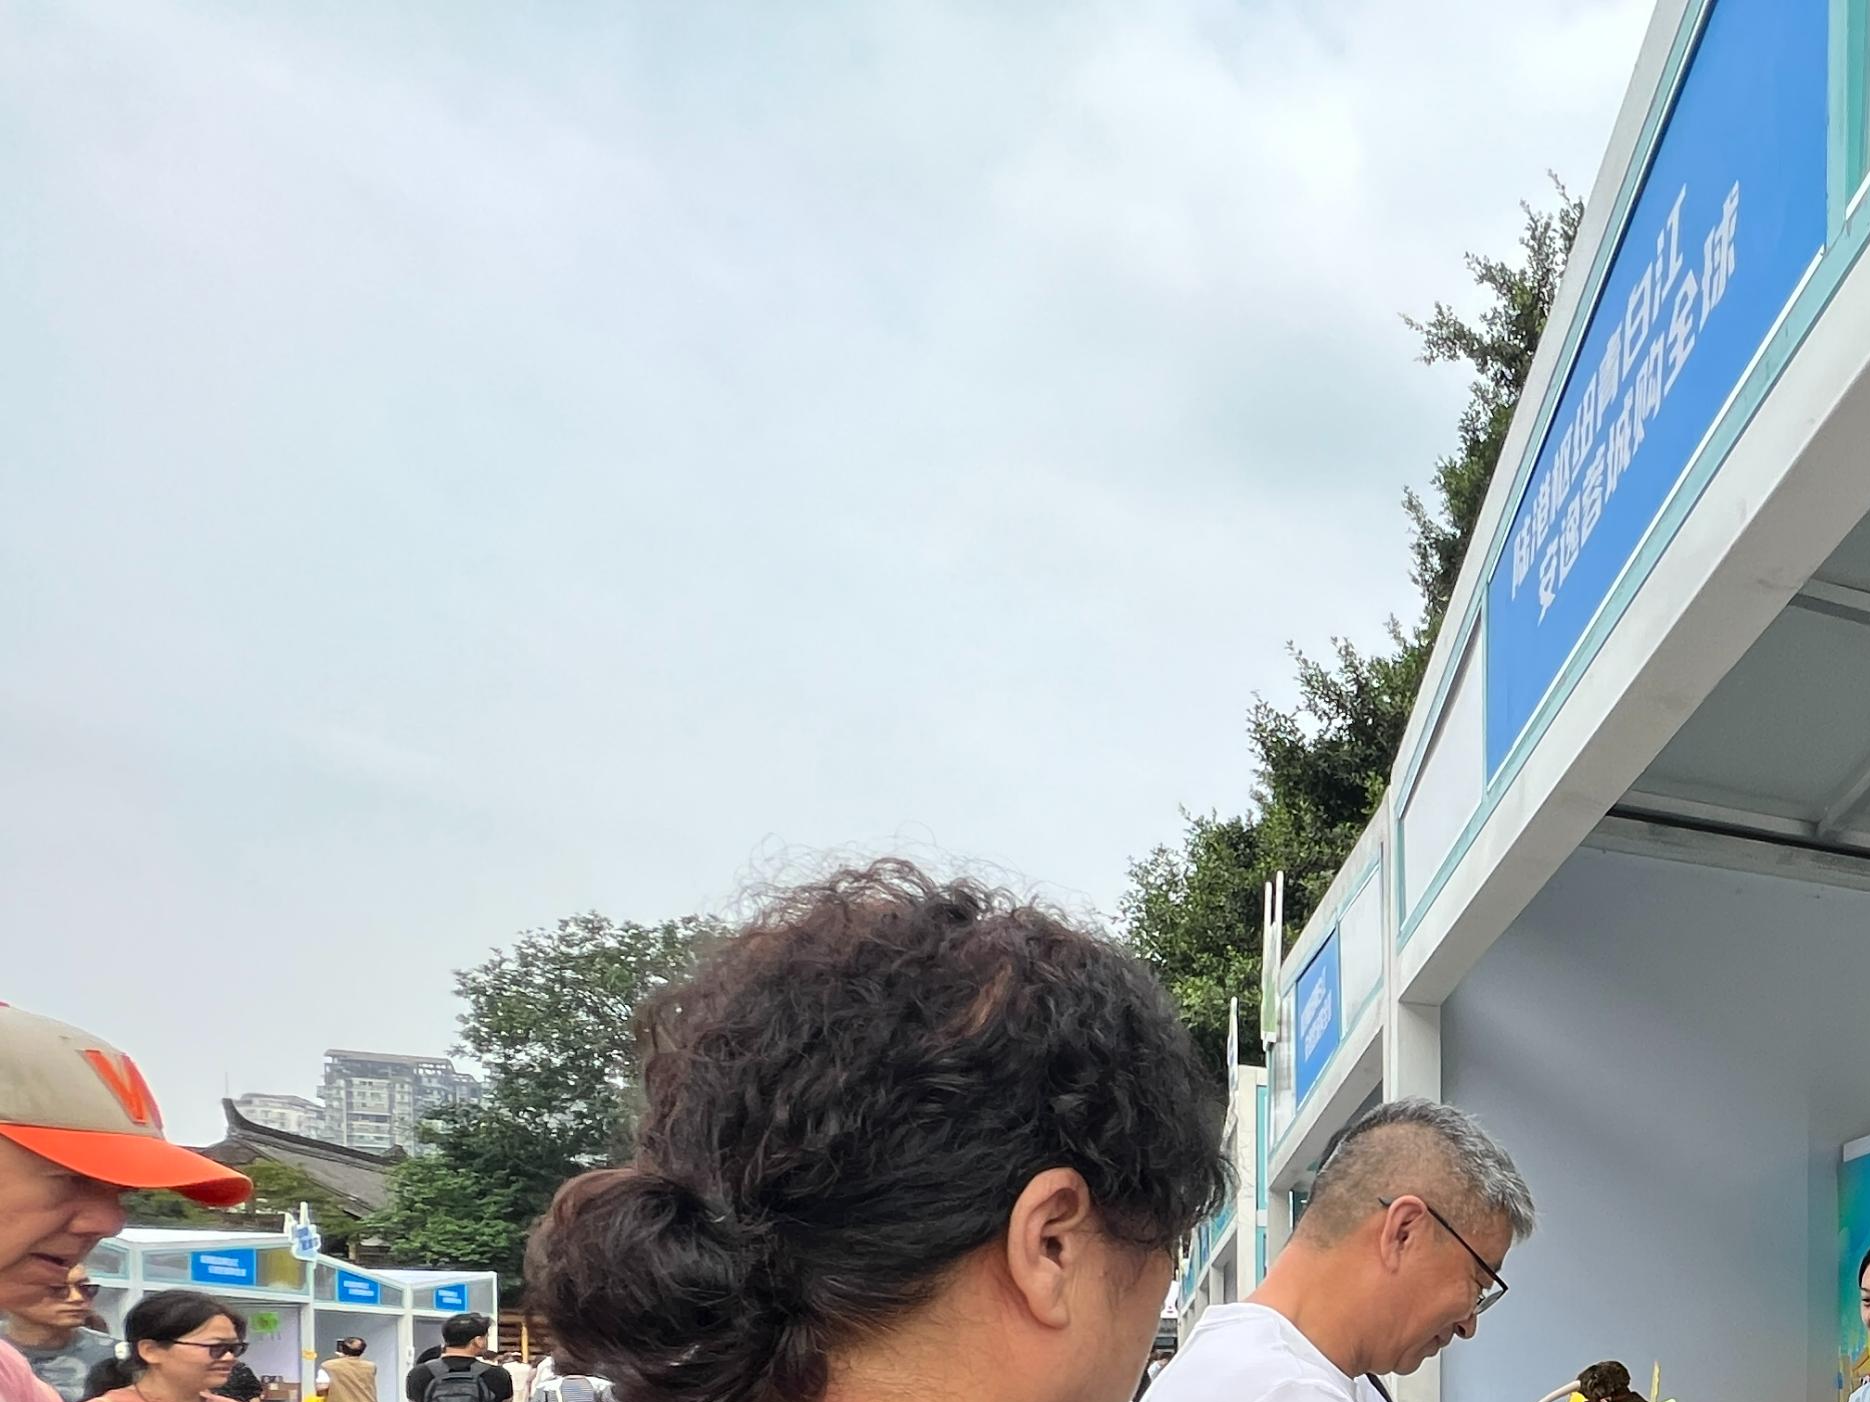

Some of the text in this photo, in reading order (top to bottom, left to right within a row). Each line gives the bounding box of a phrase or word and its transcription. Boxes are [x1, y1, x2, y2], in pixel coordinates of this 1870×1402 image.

[1511, 184, 1687, 601] 陆港枢纽青白江
[1537, 180, 1739, 626] 安逸蓉城购全球
